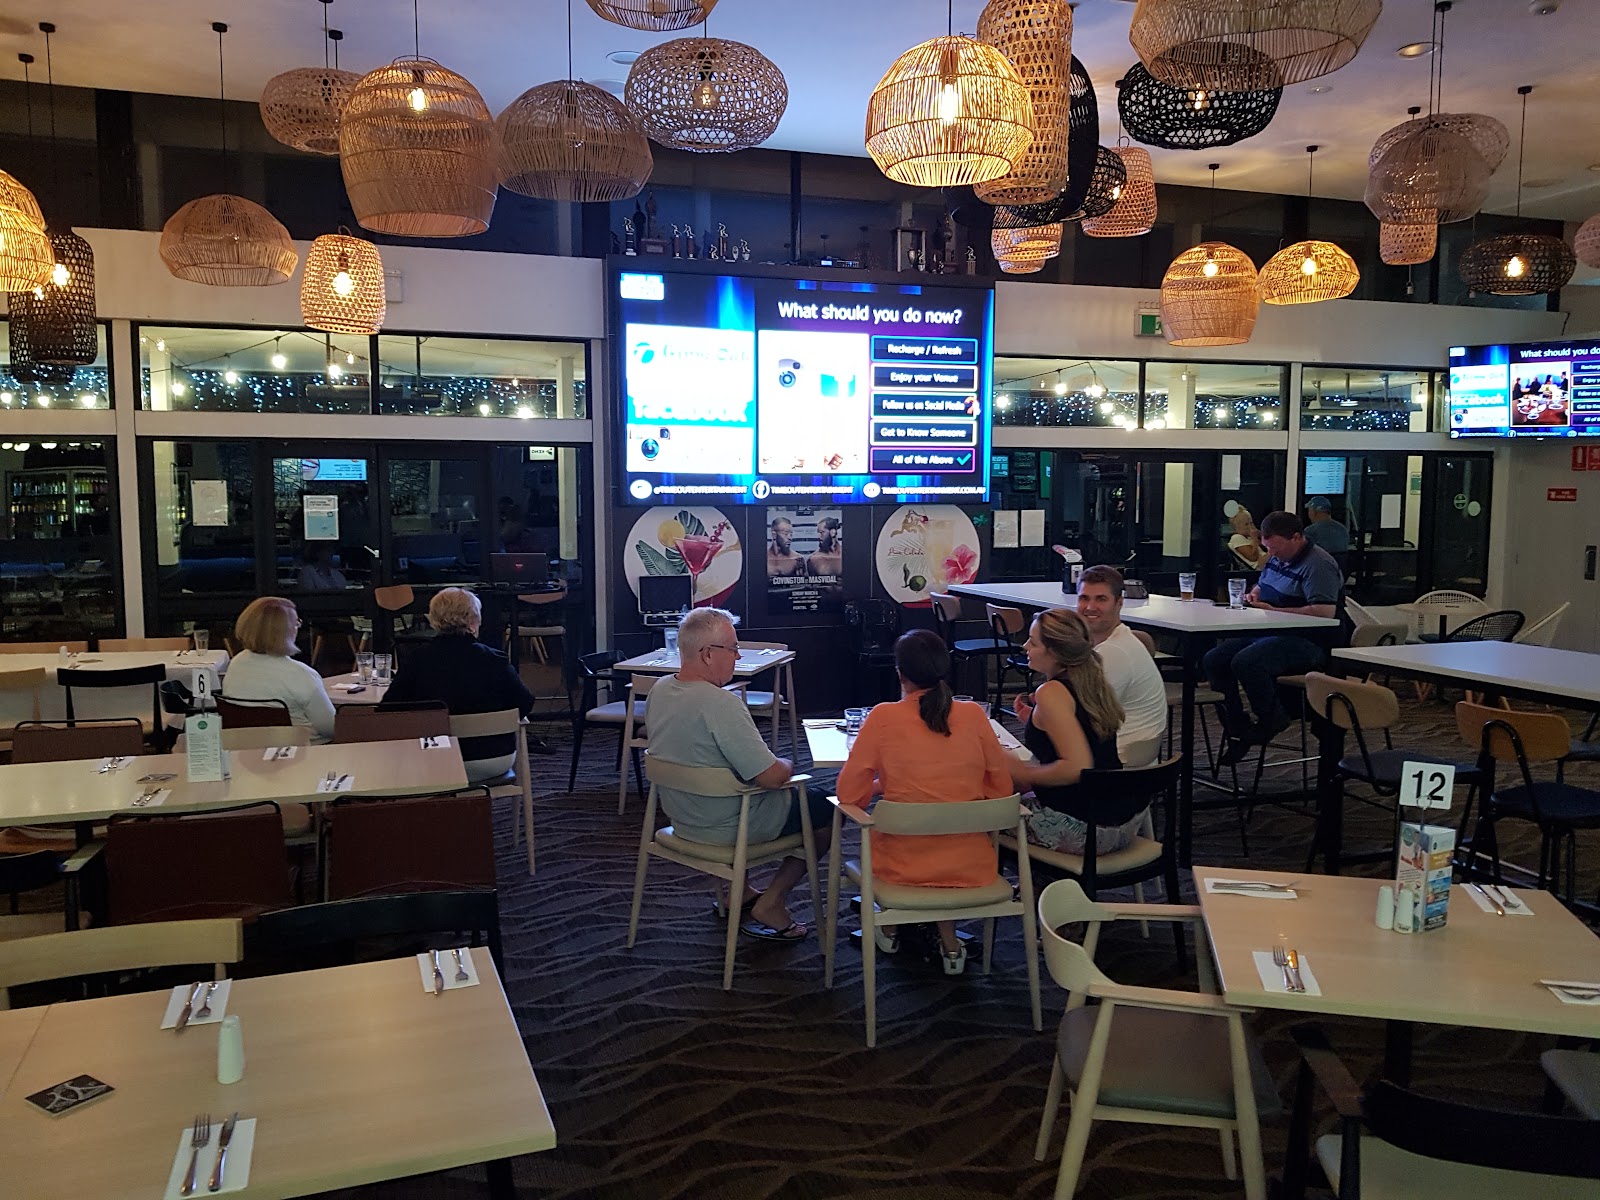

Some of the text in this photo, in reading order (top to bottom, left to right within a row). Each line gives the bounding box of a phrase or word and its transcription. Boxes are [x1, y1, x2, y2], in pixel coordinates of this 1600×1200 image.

[778, 302, 962, 325] What should you do now?
[887, 343, 925, 356] Recharge
[1520, 350, 1542, 358] What
[1543, 348, 1571, 357] should
[1572, 348, 1588, 357] you
[890, 372, 958, 383] Enjoy your Venue
[882, 399, 904, 410] Follow
[924, 400, 945, 410] Social
[880, 427, 966, 437] Get to Know Someone
[892, 455, 954, 465] All of the Above
[773, 576, 805, 585] COVINGTON
[809, 575, 837, 584] MASVIDAL
[198, 673, 205, 694] 6
[1412, 770, 1446, 802] 12
